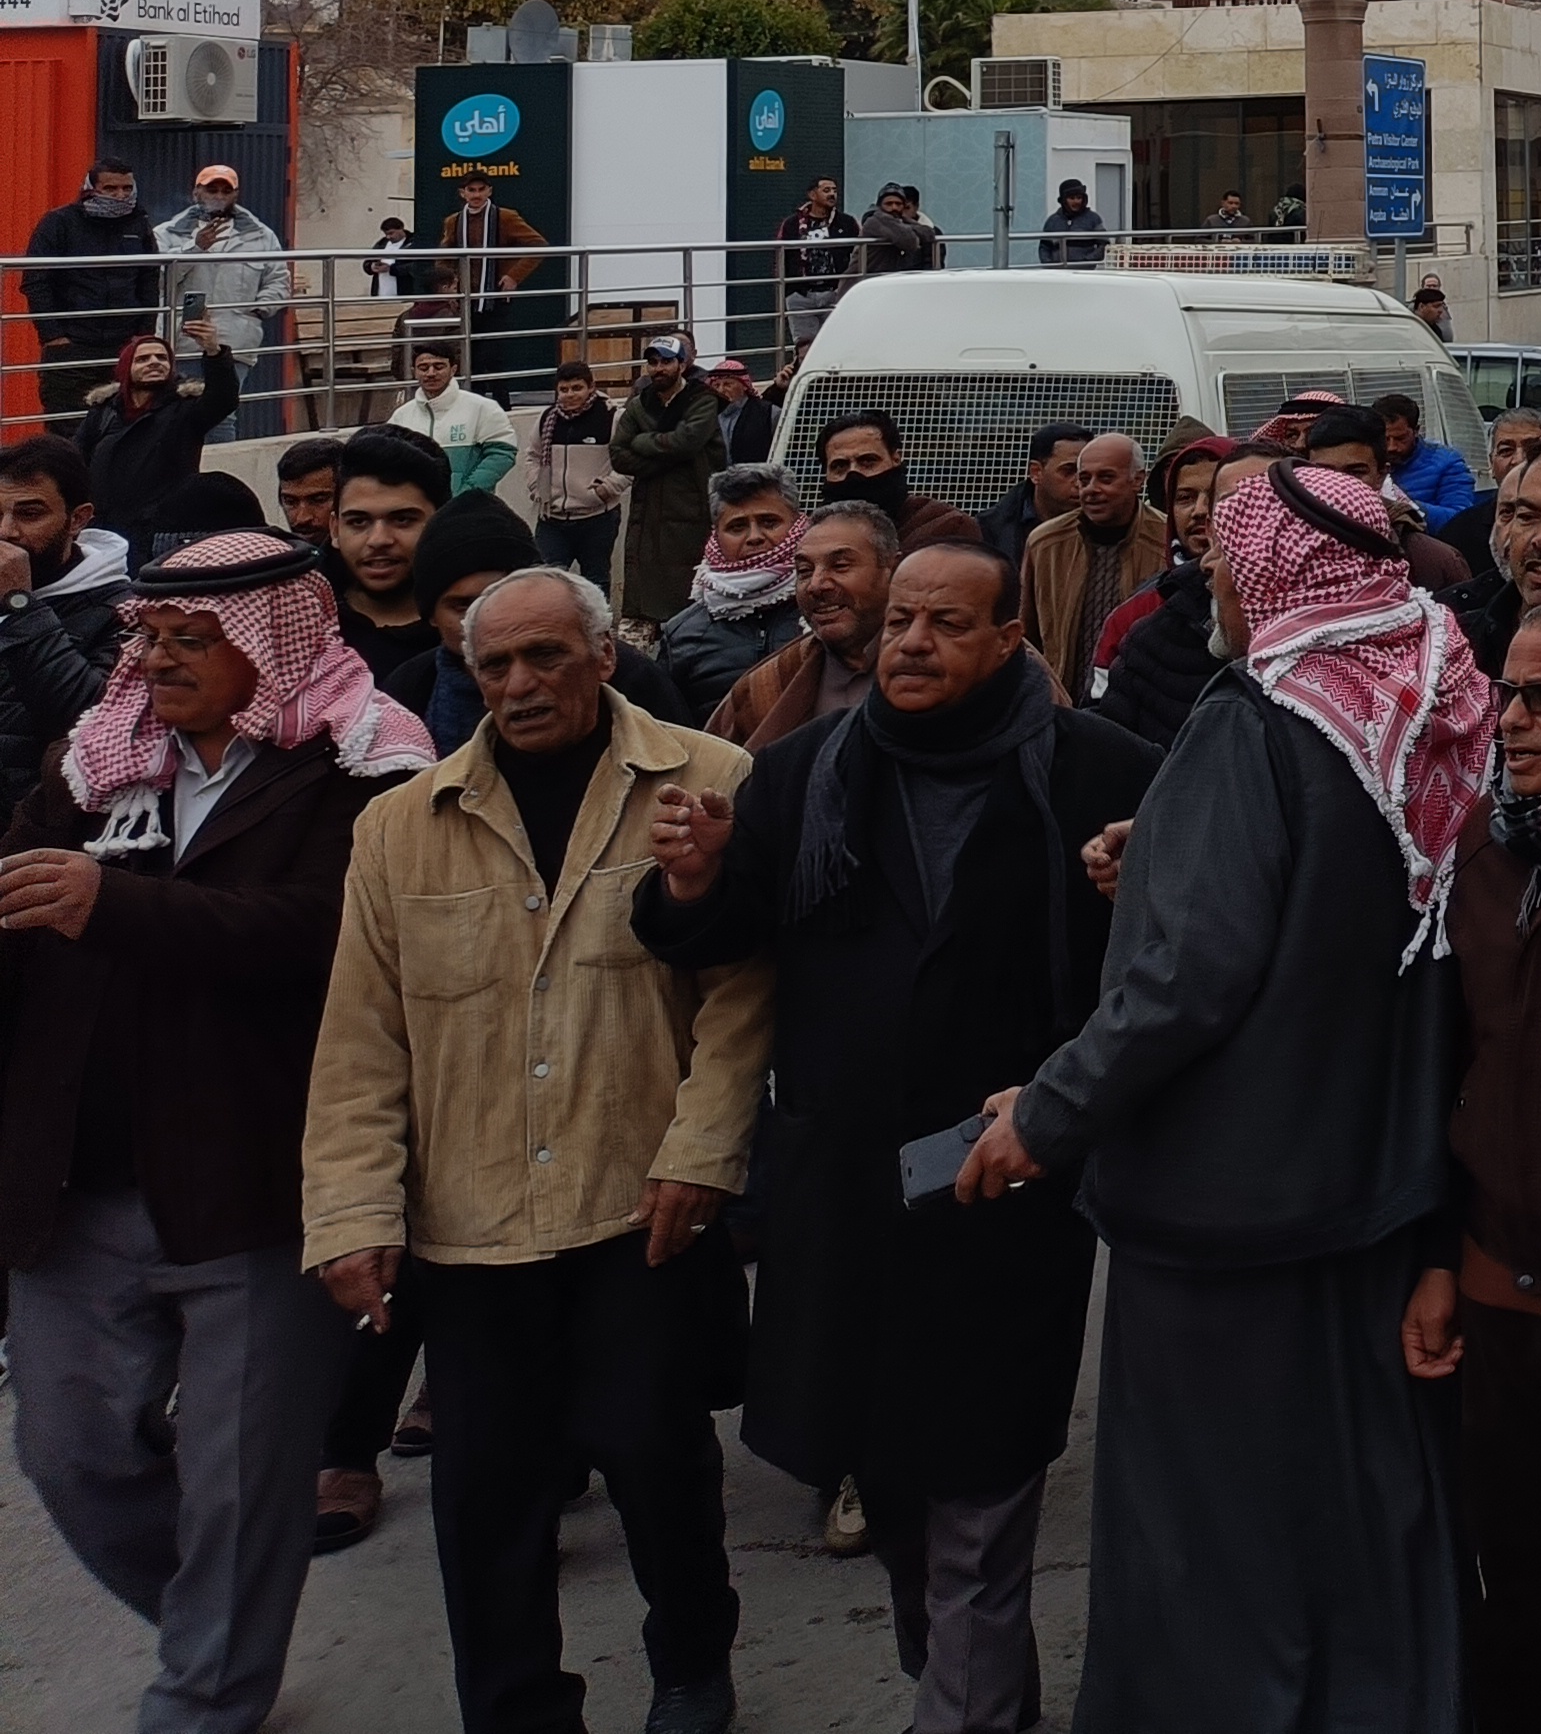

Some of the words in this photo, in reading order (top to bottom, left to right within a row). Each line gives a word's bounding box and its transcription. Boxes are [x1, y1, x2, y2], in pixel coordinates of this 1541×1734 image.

[176, 1, 190, 22] al
[194, 3, 241, 27] Etihad
[454, 104, 506, 143] أهلي
[754, 102, 780, 137] أهلي
[1367, 132, 1383, 145] Petra
[1383, 133, 1401, 146] Visitor
[1401, 134, 1418, 147] Center
[1407, 157, 1419, 170] Park
[451, 425, 466, 434] NF
[451, 433, 466, 441] ED
